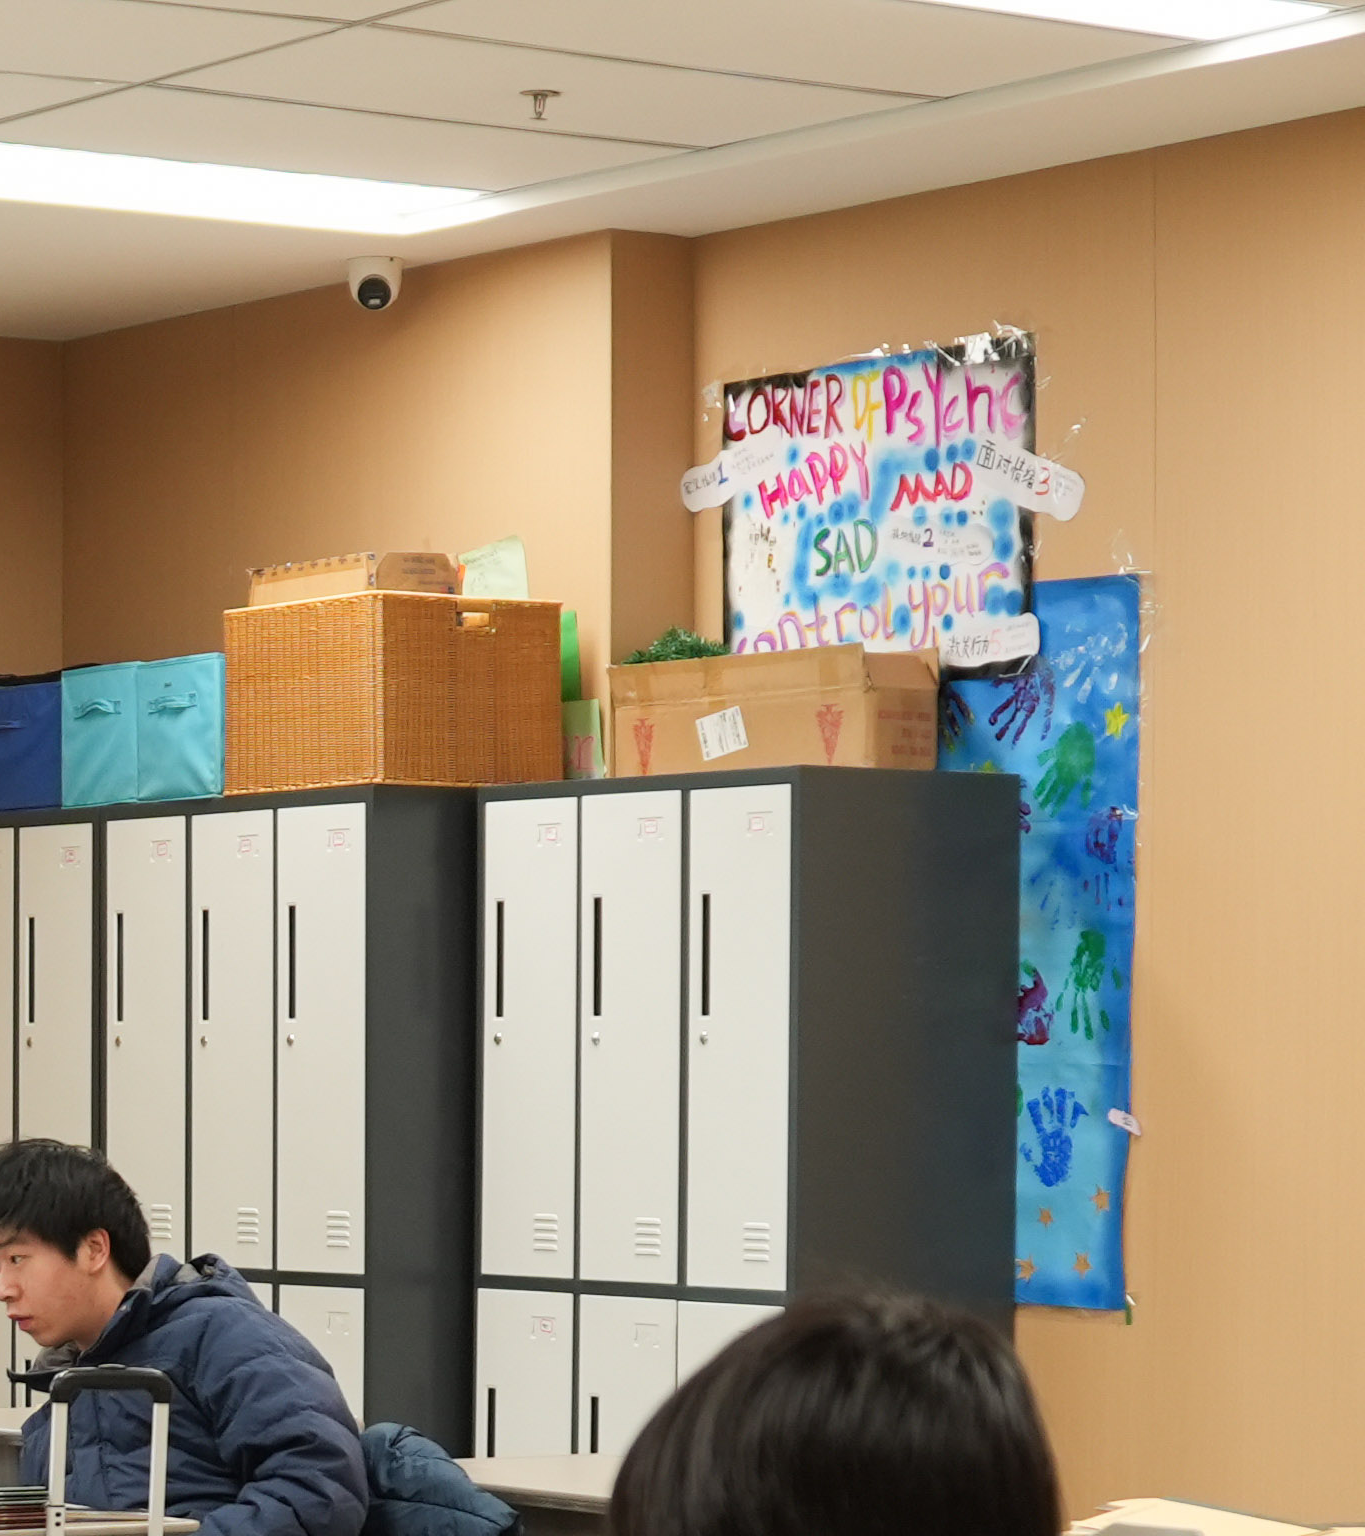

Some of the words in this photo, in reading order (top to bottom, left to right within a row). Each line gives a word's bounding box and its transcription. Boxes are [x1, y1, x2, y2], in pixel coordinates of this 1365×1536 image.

[724, 374, 844, 441] CORNER
[852, 370, 883, 441] OF
[890, 461, 973, 512] MAD
[814, 519, 877, 578] SAD
